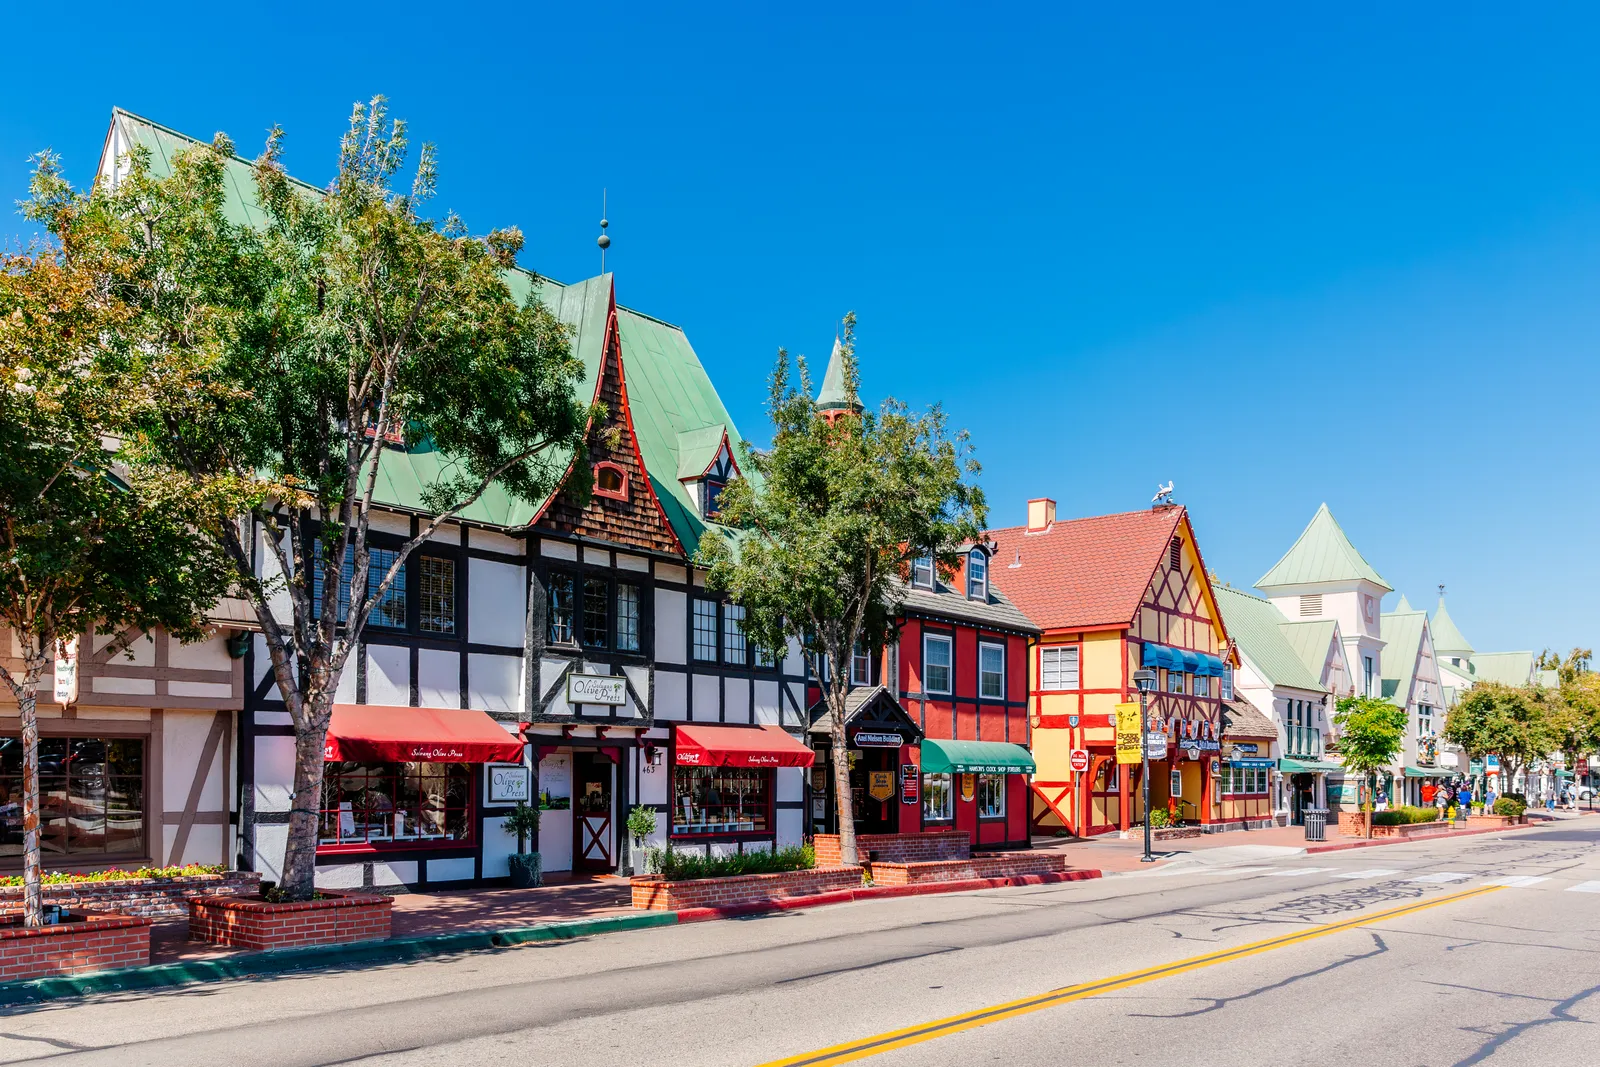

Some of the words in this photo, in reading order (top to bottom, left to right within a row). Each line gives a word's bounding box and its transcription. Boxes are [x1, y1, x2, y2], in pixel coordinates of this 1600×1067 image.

[574, 680, 599, 694] Olive
[592, 680, 612, 690] Solvang
[595, 689, 620, 701] Press
[412, 748, 431, 758] Solvang
[432, 748, 446, 757] Olive
[748, 756, 760, 764] Solvang
[494, 772, 516, 786] Olive
[501, 785, 524, 797] Press
